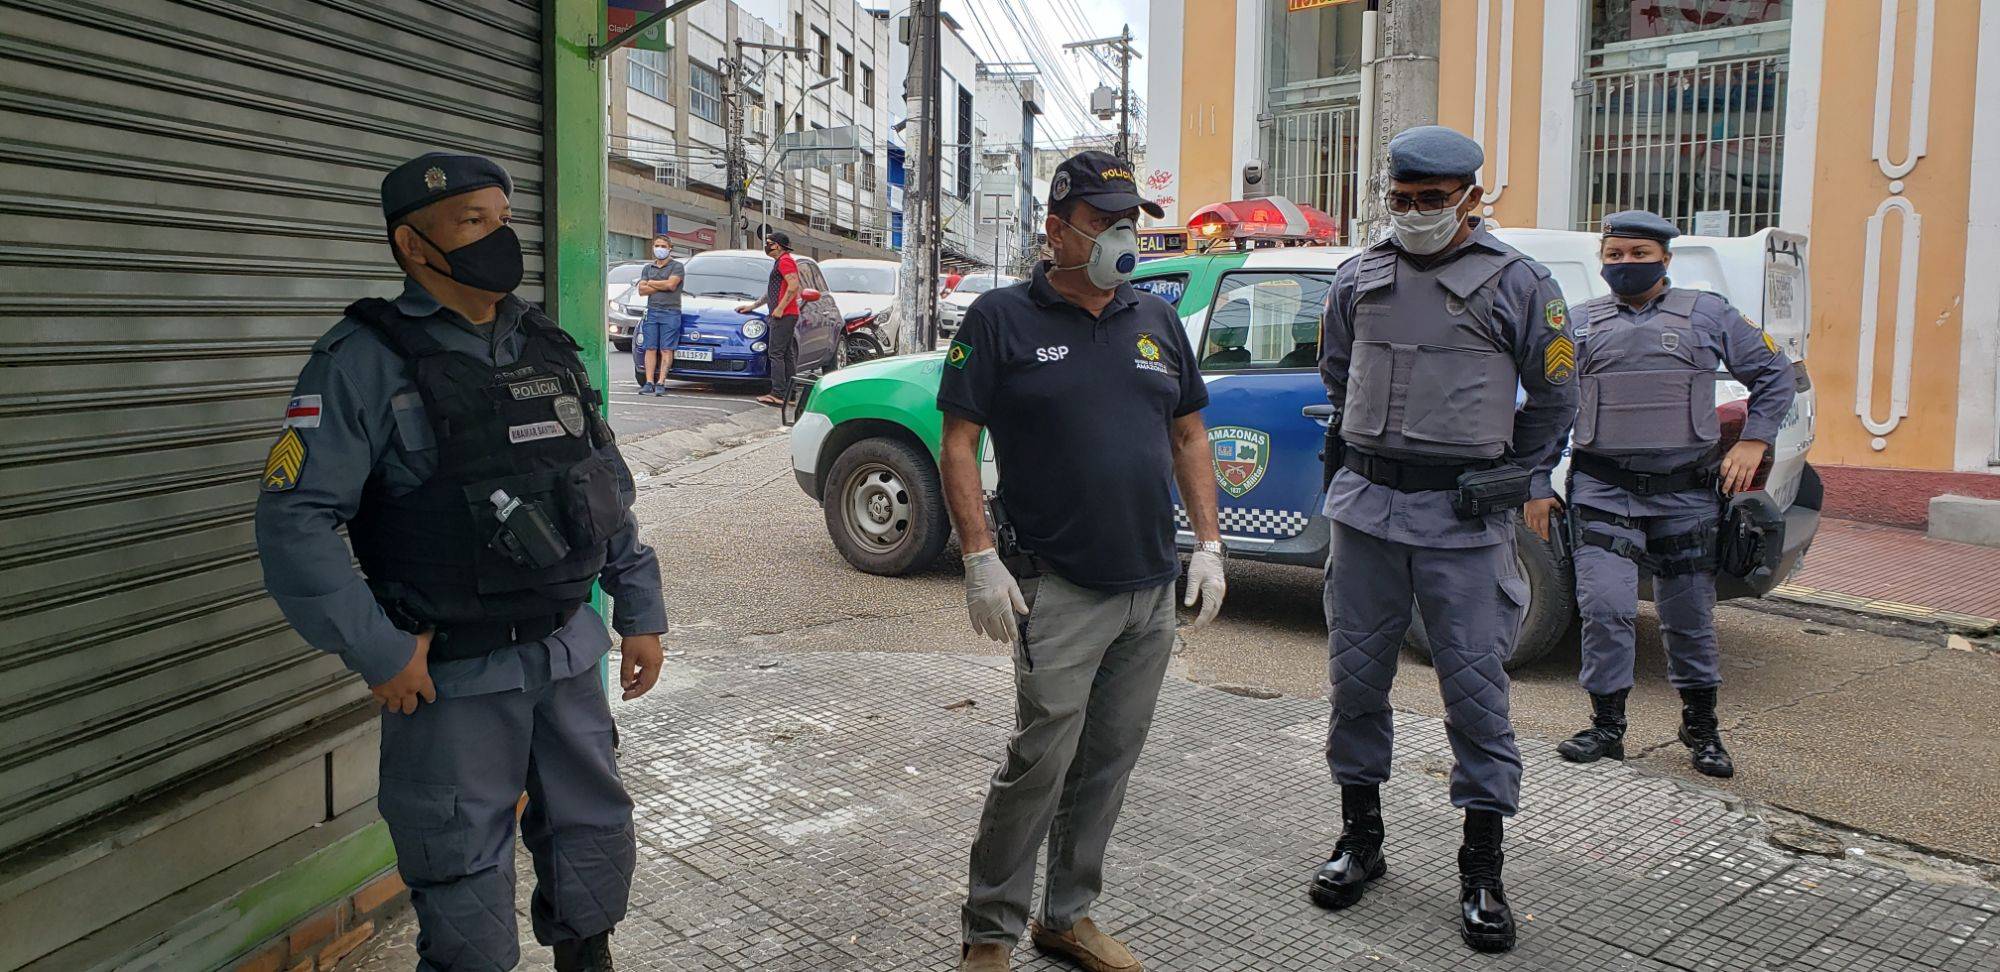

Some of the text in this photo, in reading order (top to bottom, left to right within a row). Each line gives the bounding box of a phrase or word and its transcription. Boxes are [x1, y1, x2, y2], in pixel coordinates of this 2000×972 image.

[1036, 345, 1069, 362] SSP
[512, 381, 559, 398] POLÍCIA
[1207, 428, 1266, 446] AMAZONAS
[1242, 464, 1264, 490] Militar
